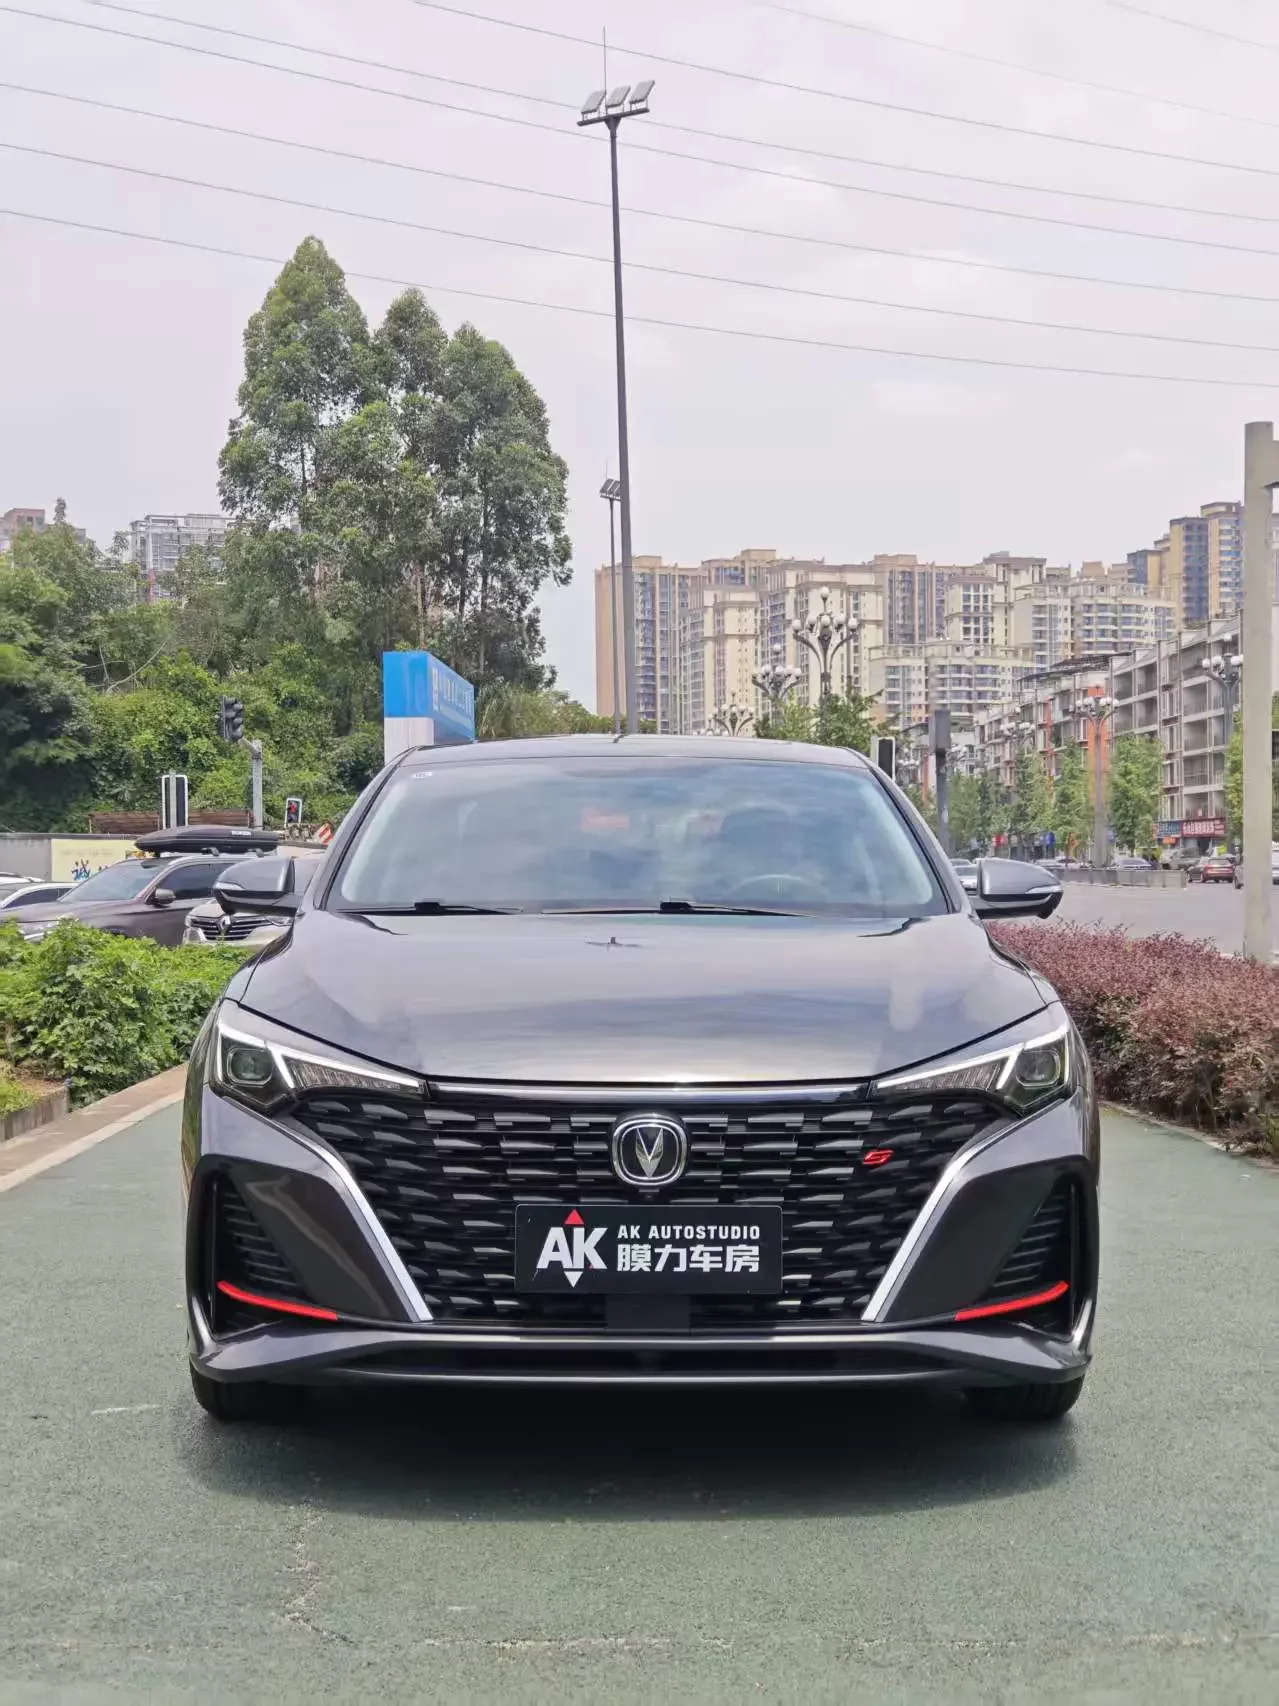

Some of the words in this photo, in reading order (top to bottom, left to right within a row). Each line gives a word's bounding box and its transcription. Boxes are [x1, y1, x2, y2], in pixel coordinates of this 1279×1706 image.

[617, 1225, 641, 1240] AK
[648, 1225, 761, 1240] AUTOSTUDIO
[536, 1226, 608, 1270] AK
[616, 1244, 760, 1273] 膜力车房
